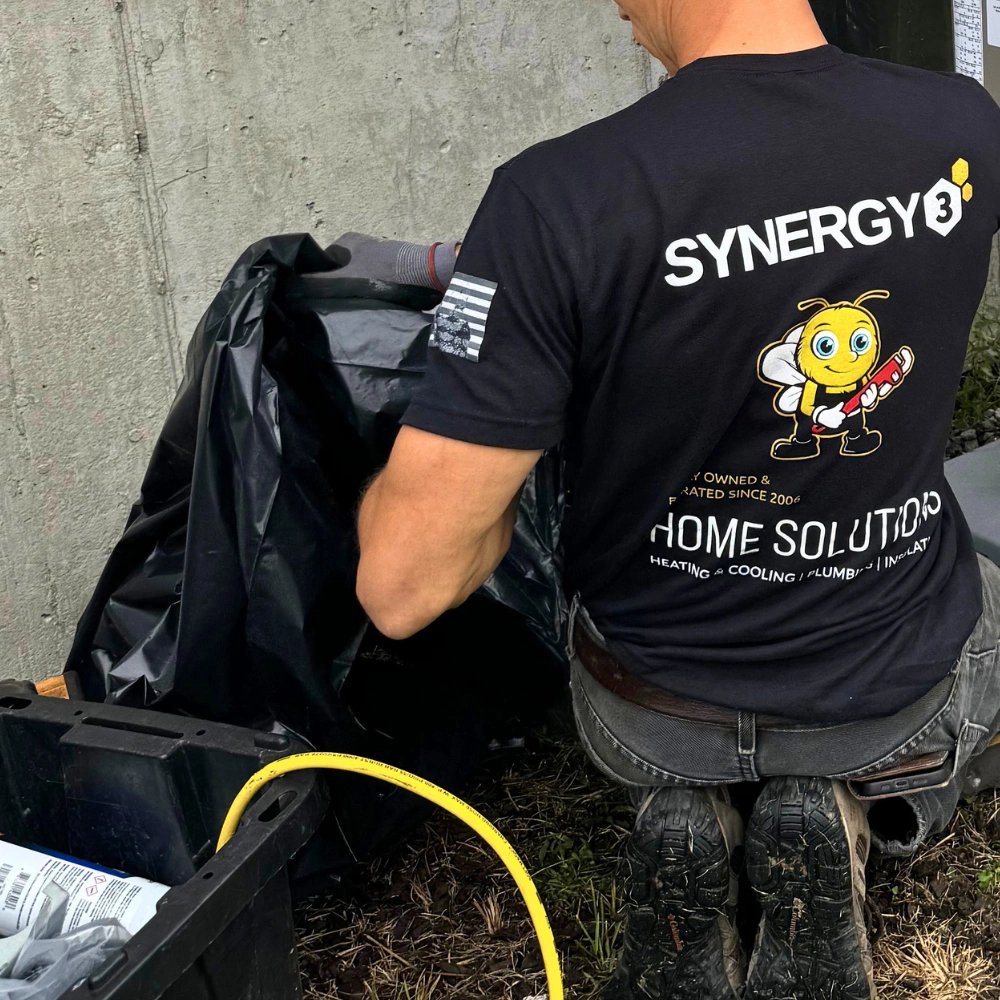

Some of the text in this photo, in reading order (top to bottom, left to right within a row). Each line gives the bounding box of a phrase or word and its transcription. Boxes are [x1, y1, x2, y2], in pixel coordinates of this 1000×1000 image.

[703, 472, 758, 485] OWNED
[760, 475, 771, 485] &
[728, 489, 768, 502] SINCE
[770, 492, 801, 506] 2006
[650, 512, 764, 559] HOME
[650, 555, 710, 579] HEATING
[728, 565, 796, 583] COOLING
[807, 561, 874, 581] PLUMBI
